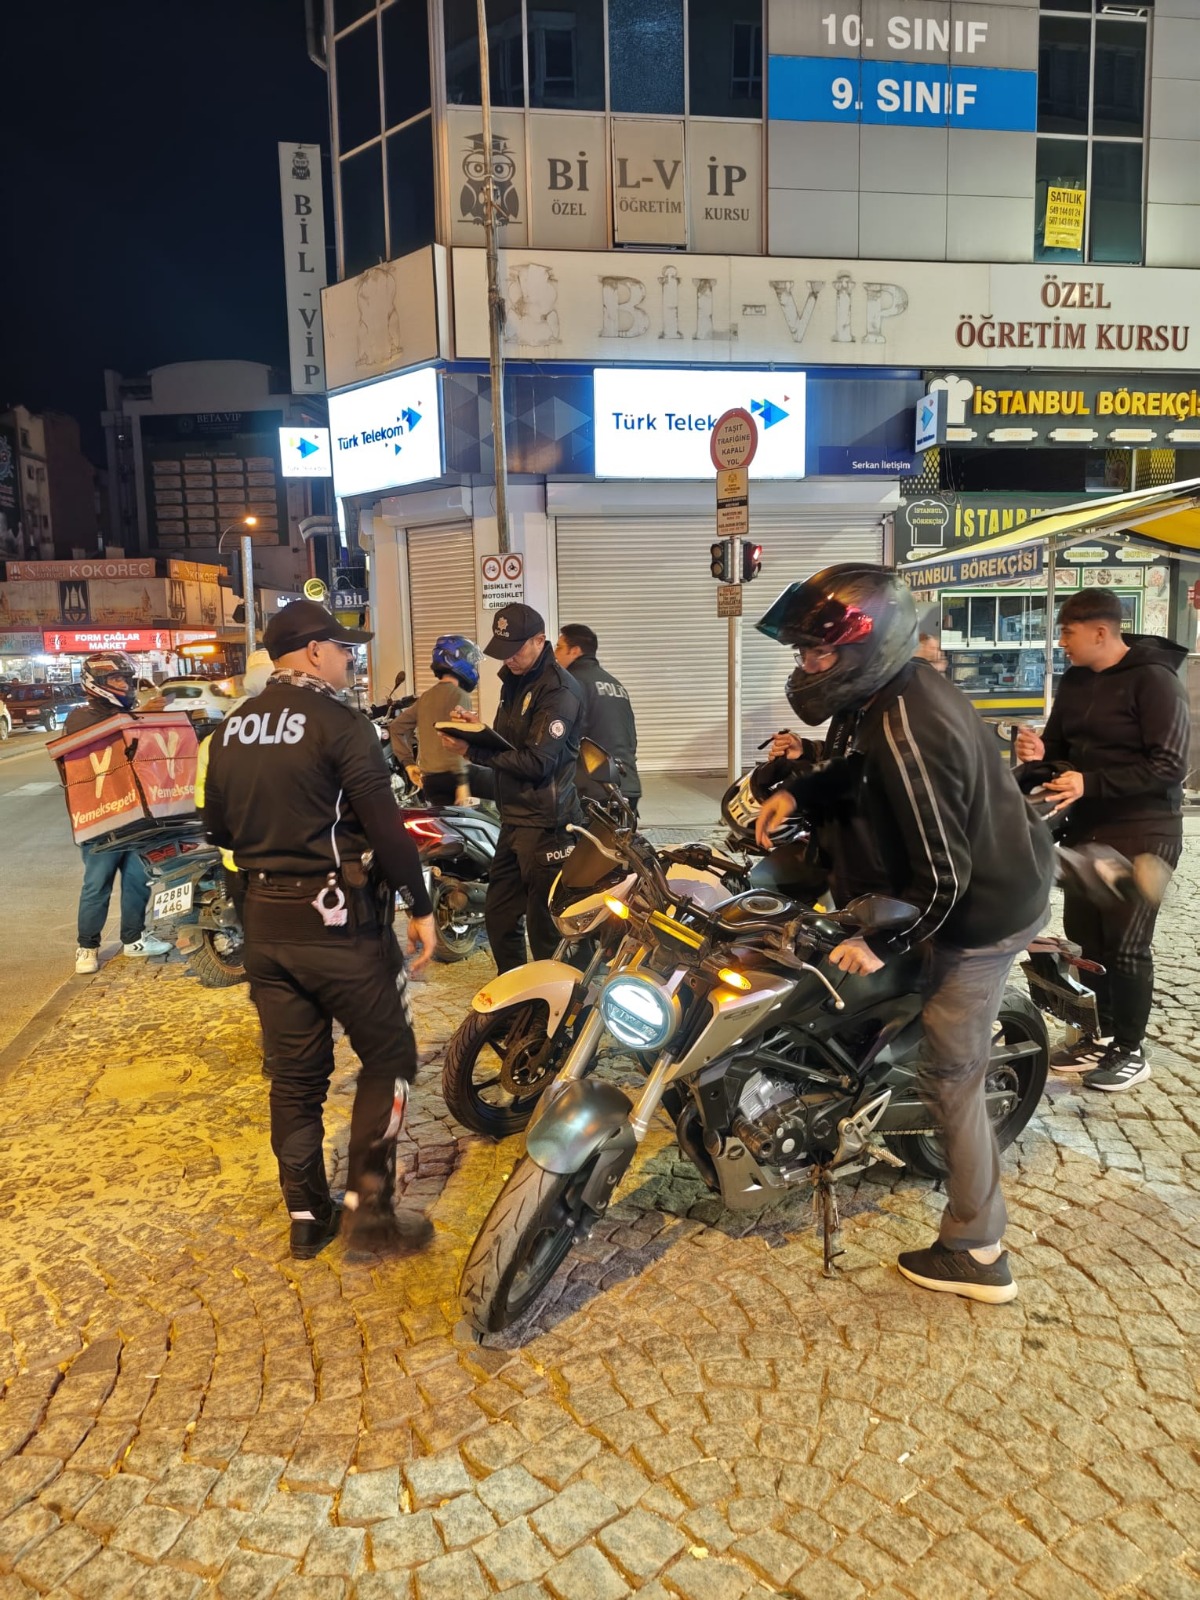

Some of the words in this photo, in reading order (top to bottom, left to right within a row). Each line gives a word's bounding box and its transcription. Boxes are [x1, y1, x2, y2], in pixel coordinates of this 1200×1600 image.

[822, 13, 874, 47] 10.
[887, 15, 989, 54] SINIF
[831, 76, 863, 111] 9.
[876, 78, 978, 115] SINIF
[1050, 190, 1082, 205] SATILIK
[551, 198, 587, 216] ÖZEL
[619, 196, 683, 214] ÖĞRETİM
[704, 207, 750, 222] KURSU
[1040, 273, 1112, 310] ÖZEL
[955, 313, 1087, 350] ÖĞRETİM
[1094, 323, 1190, 352] KURSU
[973, 385, 1091, 416] İSTANBUL
[1096, 387, 1200, 422] BÖREKÇİ
[196, 414, 221, 424] BETA
[612, 412, 657, 431] Türk
[664, 412, 718, 431] Telek
[724, 423, 744, 434] TAŞIT
[337, 434, 359, 451] Türk
[361, 424, 404, 445] Telekom
[721, 446, 745, 456] KAPALI
[726, 458, 740, 466] YOL
[851, 460, 880, 469] Serkan
[881, 459, 911, 471] İletişim
[914, 506, 943, 514] İSTANBUL
[954, 503, 1051, 538] İSTAN
[960, 545, 1039, 581] BÖREKÇİSİ
[189, 570, 219, 583] KOKORE
[483, 582, 513, 591] BİSİKLET
[482, 591, 523, 600] MOTOSİKLET
[75, 634, 101, 642] FORM
[103, 631, 140, 643] ÇAĞLAR
[89, 641, 127, 650] MARKET
[222, 707, 307, 747] POLİS
[147, 783, 195, 802] Yemekse
[71, 788, 137, 829] Yemeksepeti
[162, 900, 183, 914] 446
